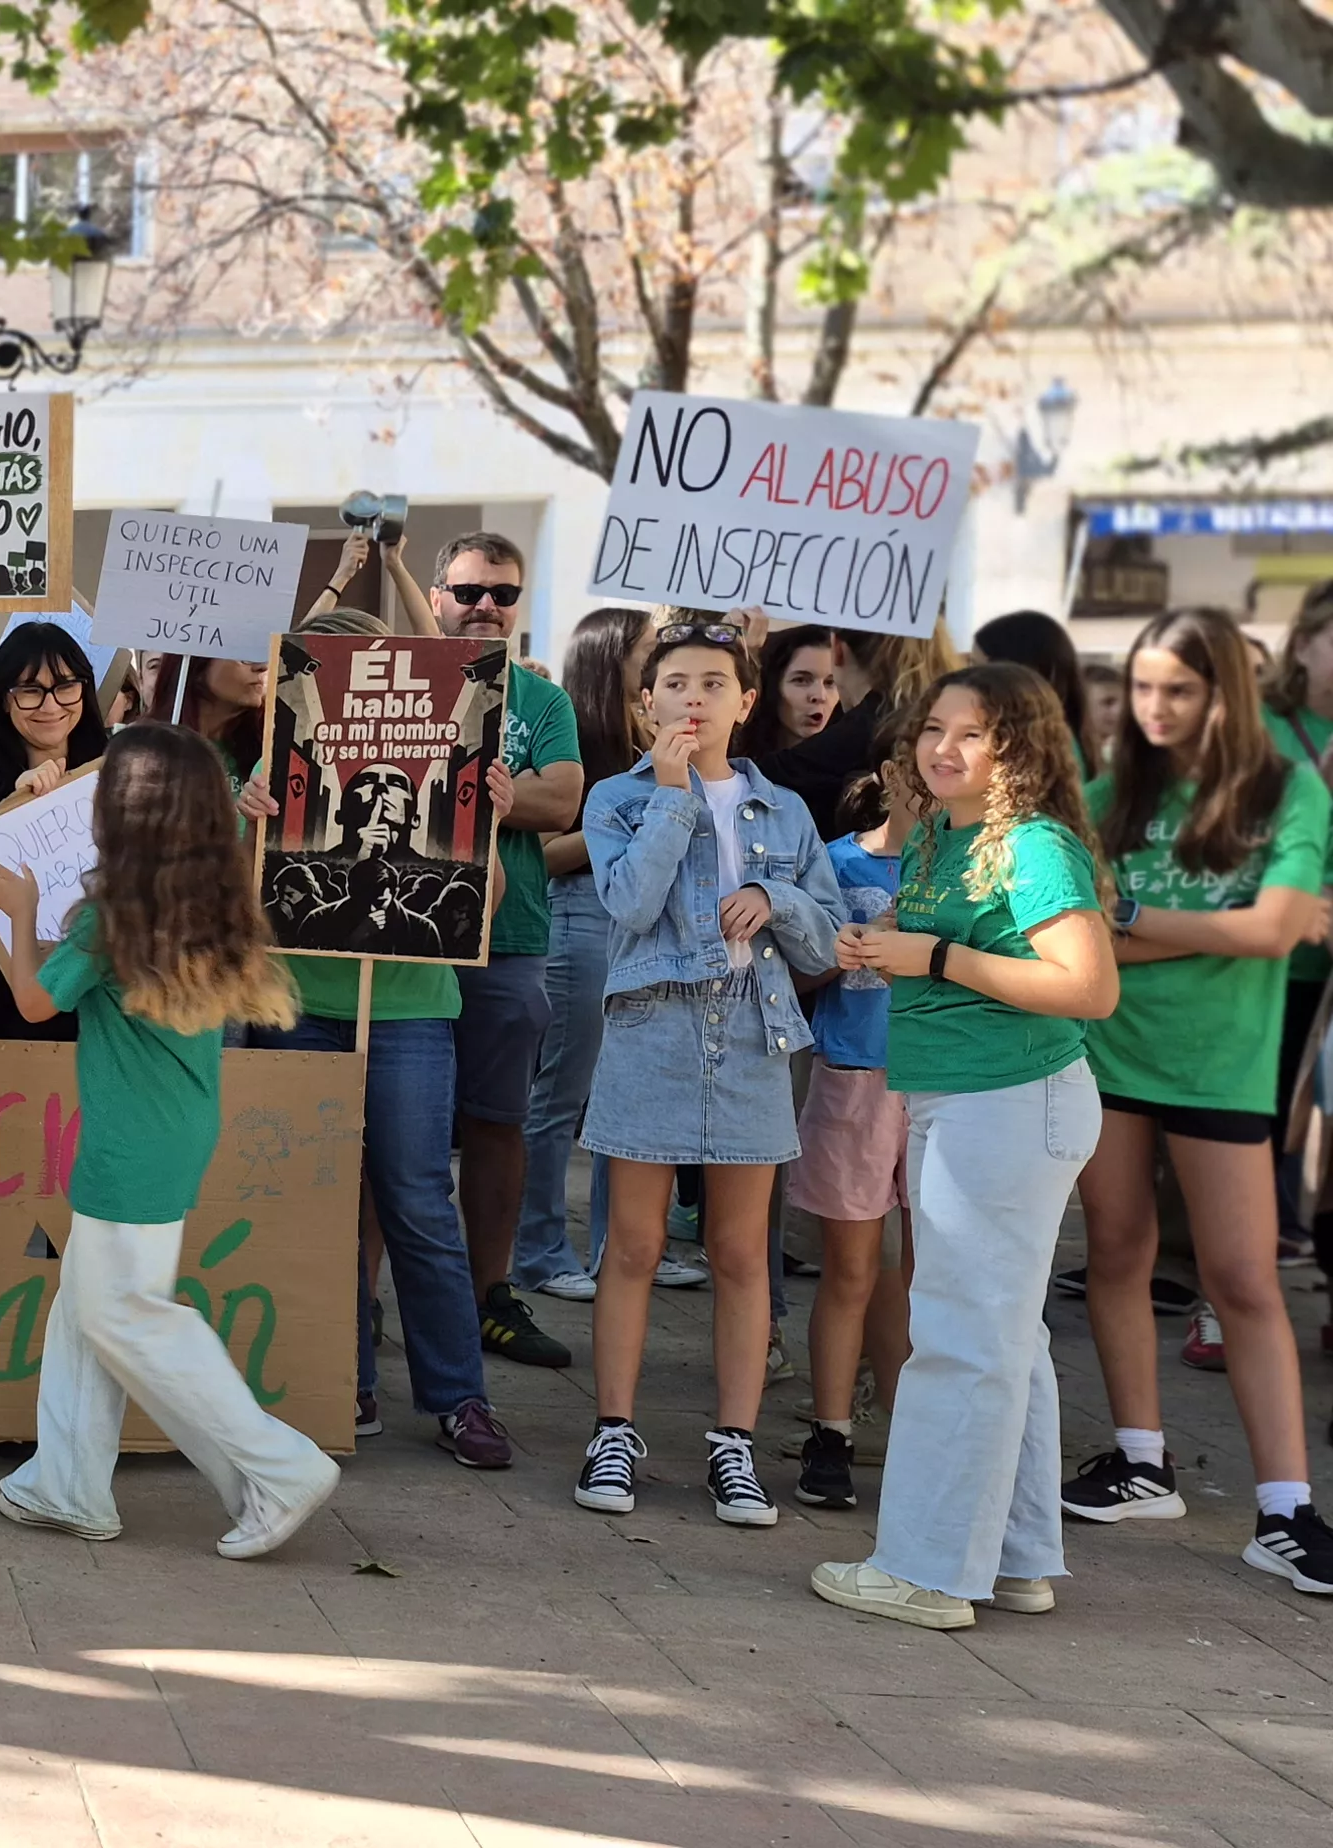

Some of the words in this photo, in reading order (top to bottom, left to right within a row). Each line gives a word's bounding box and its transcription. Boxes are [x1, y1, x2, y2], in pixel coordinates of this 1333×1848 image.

[629, 406, 732, 493] NO
[739, 442, 800, 505] AL
[805, 447, 949, 520] ABUSO
[120, 520, 222, 550] QUIERO
[239, 534, 279, 555] UNA
[123, 550, 275, 587] INSPECCIÓN
[593, 515, 660, 591] DE
[667, 529, 934, 625] INSPECCIÓN
[168, 580, 220, 606] ÚTIL
[146, 618, 224, 647] JUSTA
[349, 639, 430, 691] ÉL
[342, 692, 434, 719] habló
[317, 722, 342, 740] en
[348, 720, 375, 740] mi
[380, 720, 457, 740] nombre
[325, 746, 335, 764] y
[339, 745, 358, 760] se
[361, 743, 377, 759] lo
[383, 743, 451, 759] llevaron
